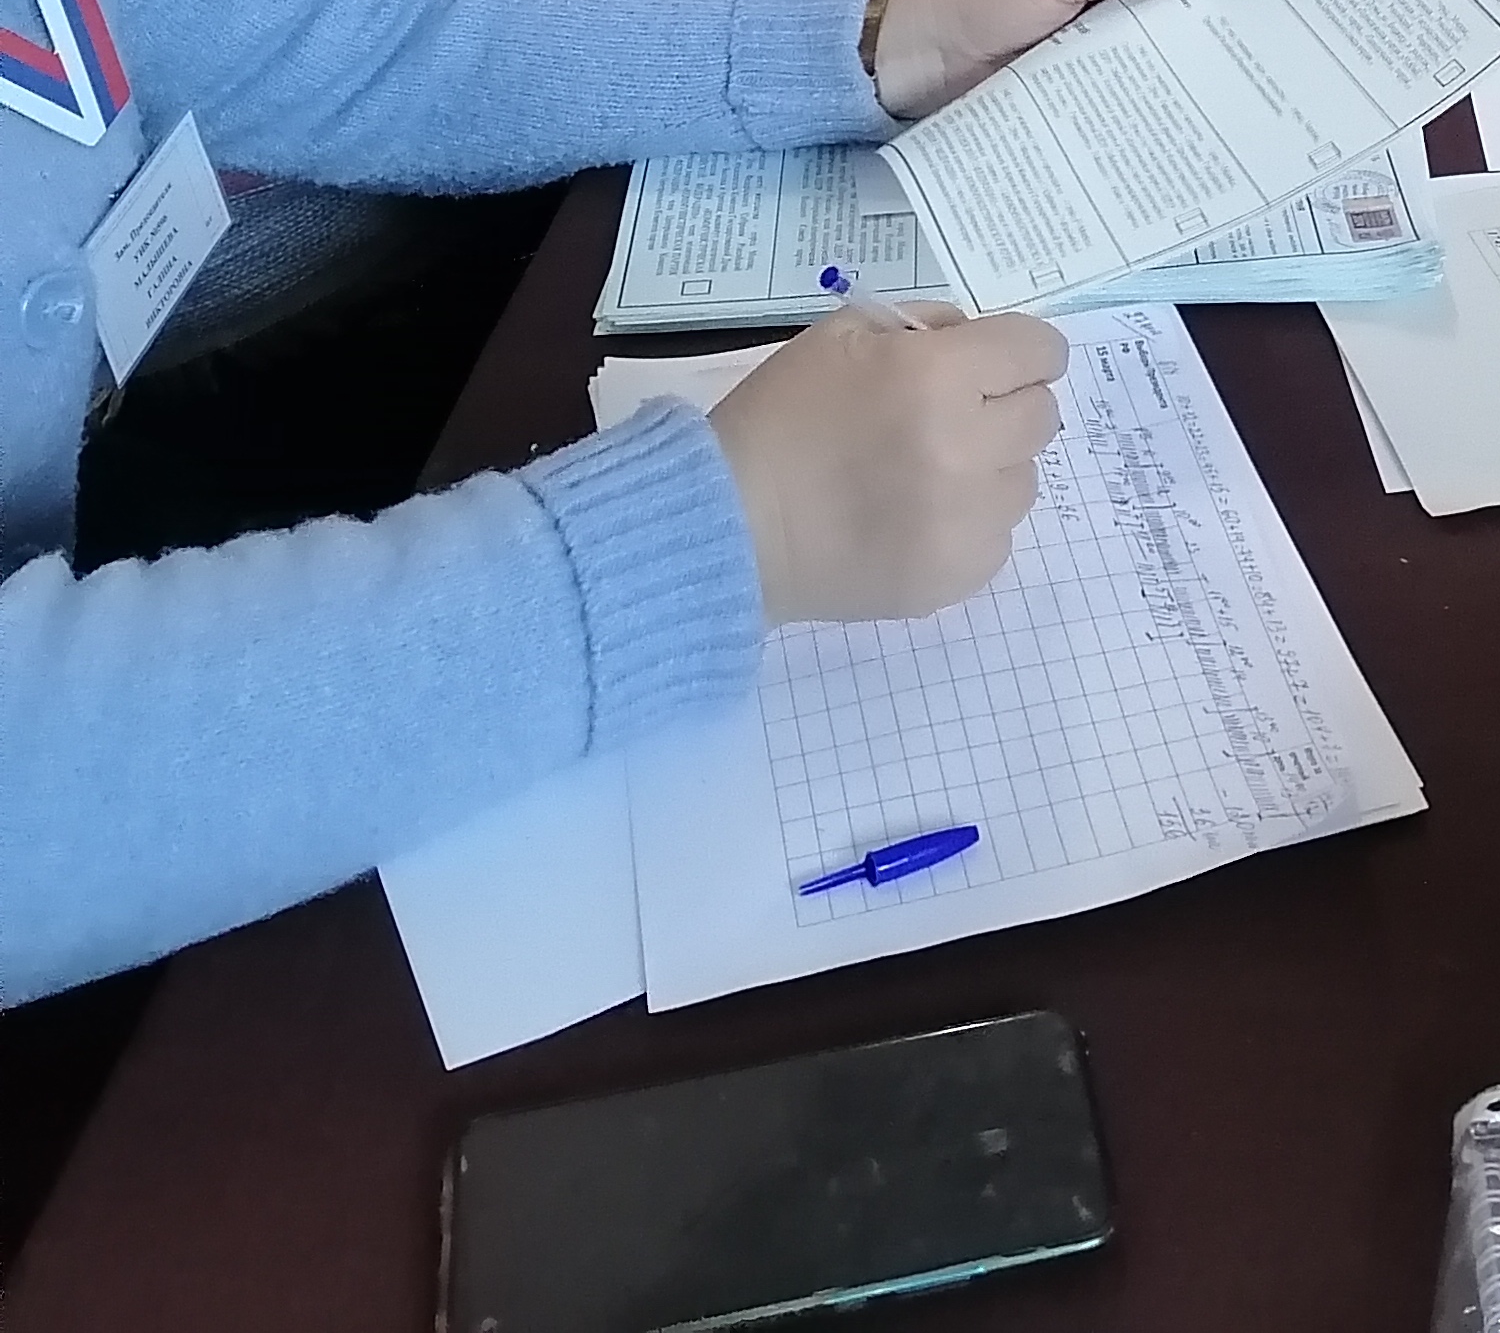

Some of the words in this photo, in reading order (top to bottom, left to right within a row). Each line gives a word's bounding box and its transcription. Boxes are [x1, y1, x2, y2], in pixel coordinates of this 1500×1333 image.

[146, 255, 178, 300] ГАЛИНА
[1095, 345, 1108, 357] 15
[1100, 357, 1116, 383] марта
